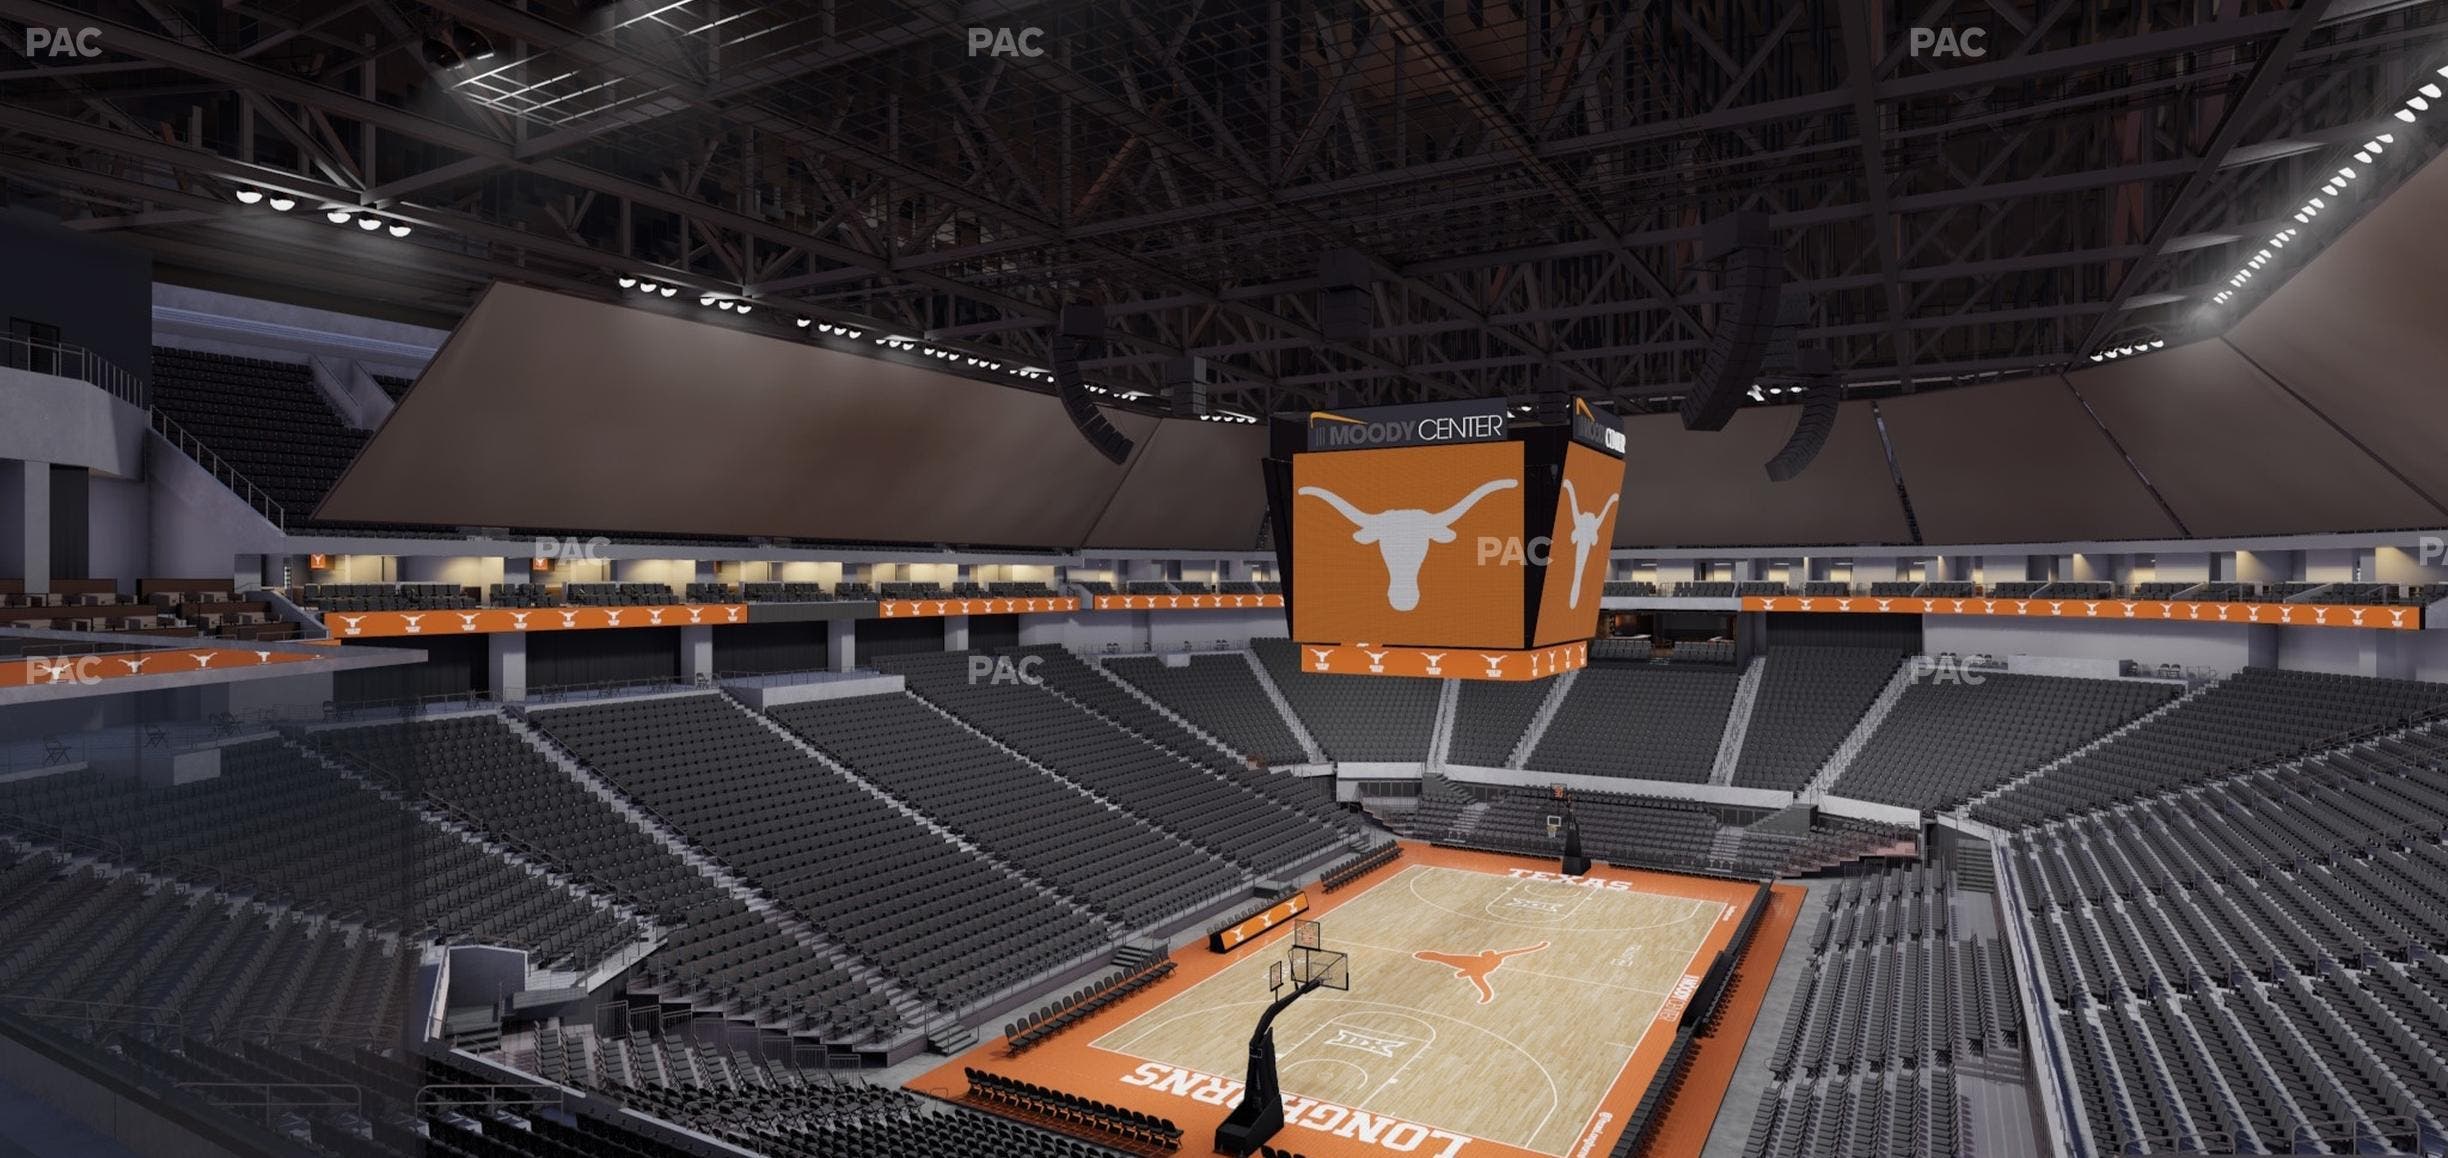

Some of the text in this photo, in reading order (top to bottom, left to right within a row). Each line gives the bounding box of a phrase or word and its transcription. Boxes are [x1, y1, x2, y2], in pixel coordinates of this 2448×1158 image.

[1330, 414, 1503, 446] MOODY CENTER
[1504, 868, 1633, 891] TEXAS
[1120, 1062, 1473, 1158] LONGHRNS
